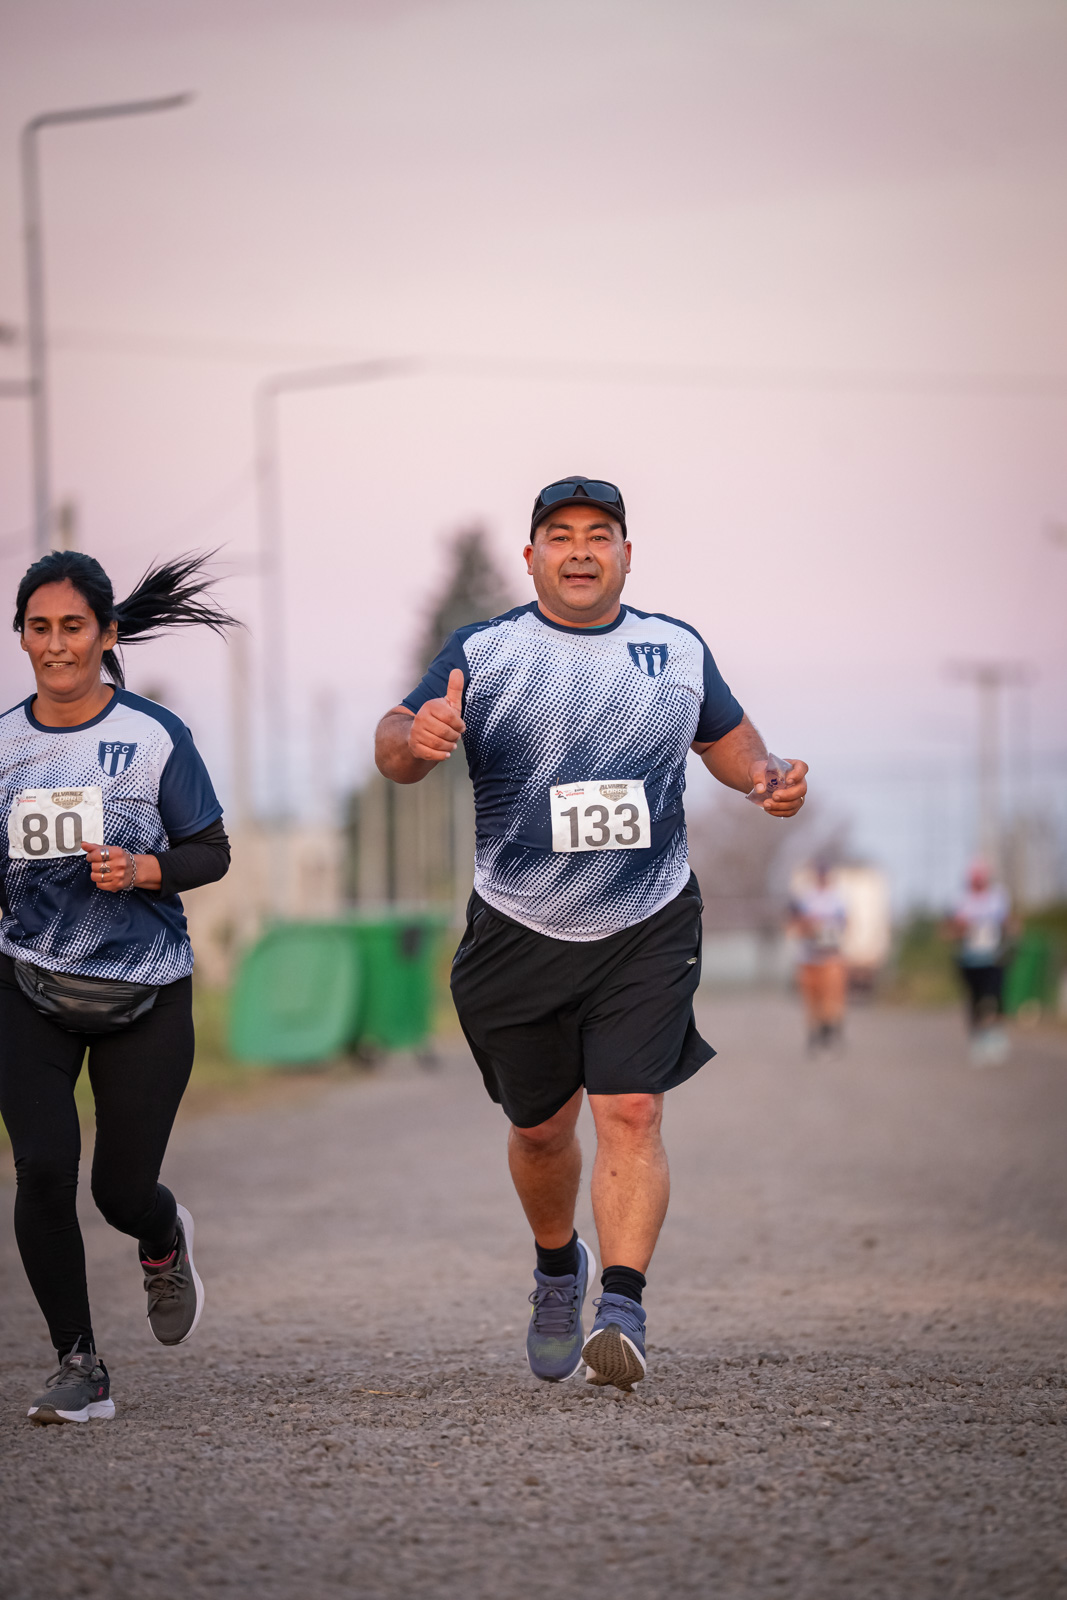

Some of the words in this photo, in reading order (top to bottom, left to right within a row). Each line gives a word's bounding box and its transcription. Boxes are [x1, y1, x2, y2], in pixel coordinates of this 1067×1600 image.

[634, 646, 661, 655] SFC
[105, 744, 130, 754] SFC
[22, 811, 83, 856] 80
[560, 803, 641, 848] 133
